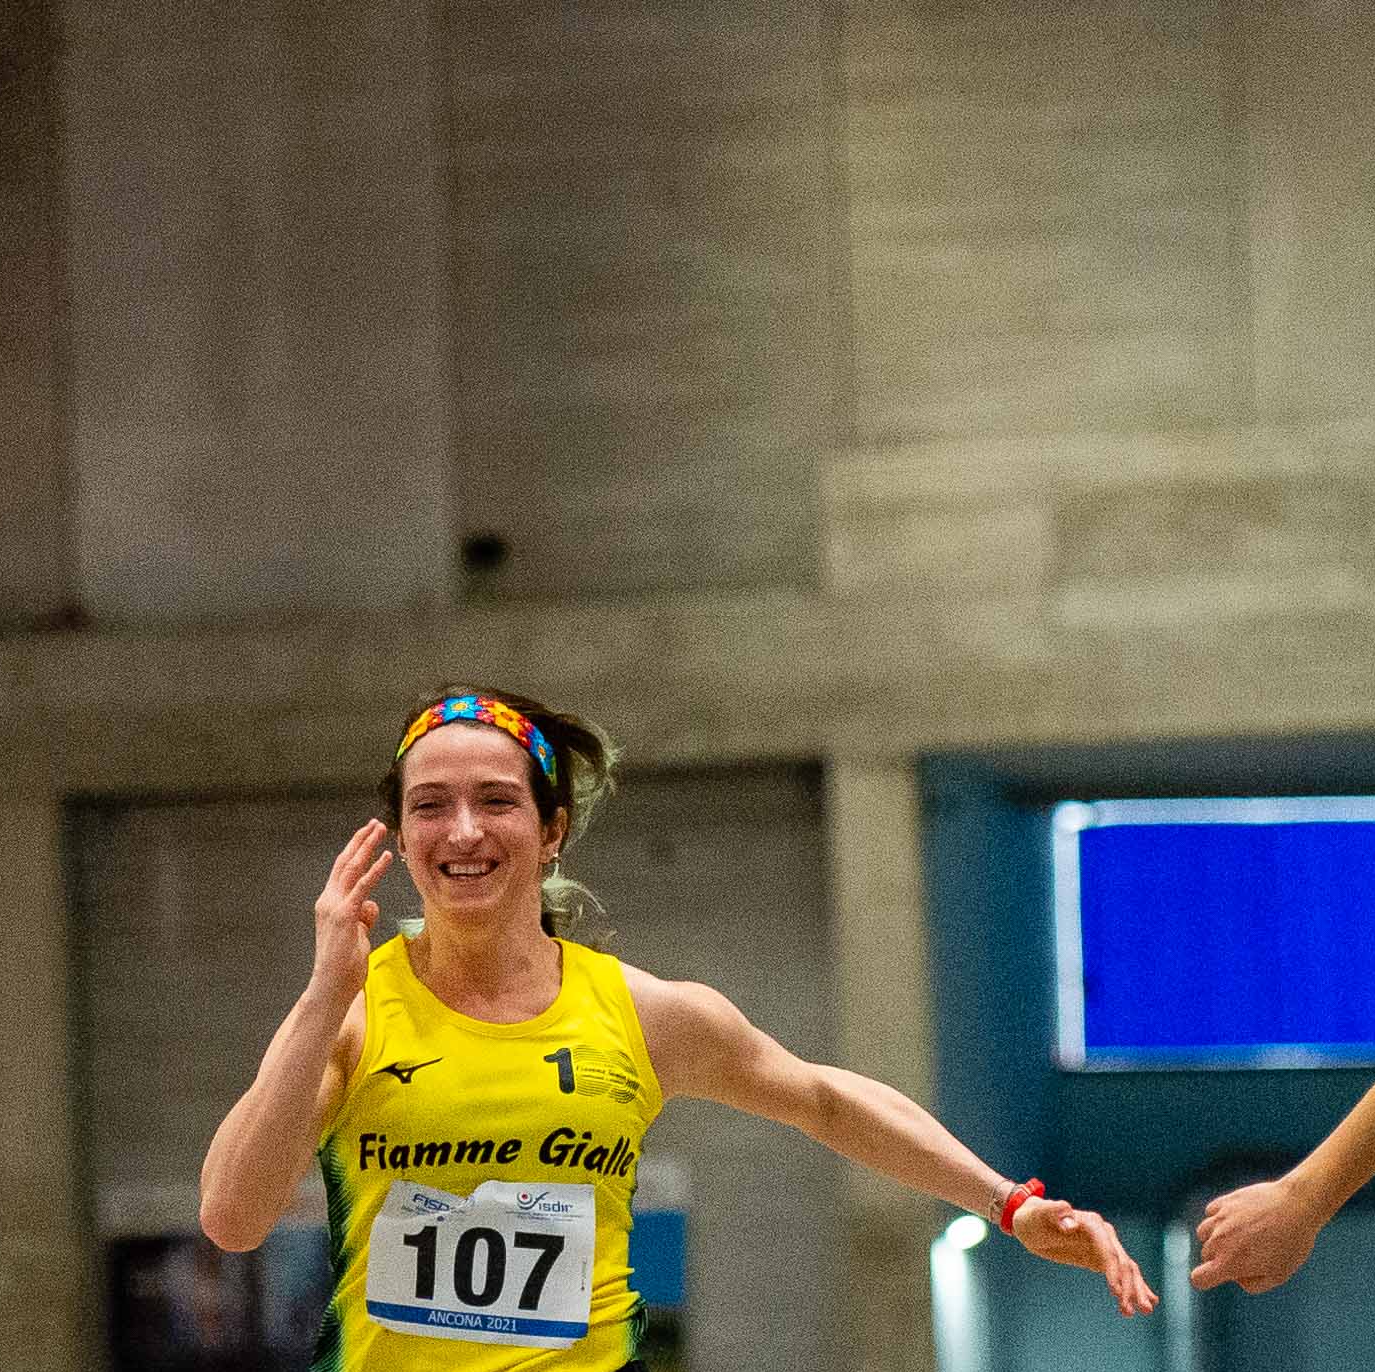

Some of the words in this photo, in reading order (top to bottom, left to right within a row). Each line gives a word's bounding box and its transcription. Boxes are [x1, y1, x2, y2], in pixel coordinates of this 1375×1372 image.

[358, 1132, 523, 1171] Fiamme
[538, 1126, 636, 1178] Gialle
[403, 1225, 565, 1311] 107
[428, 1310, 483, 1328] ANCONA
[487, 1317, 518, 1332] 2021
